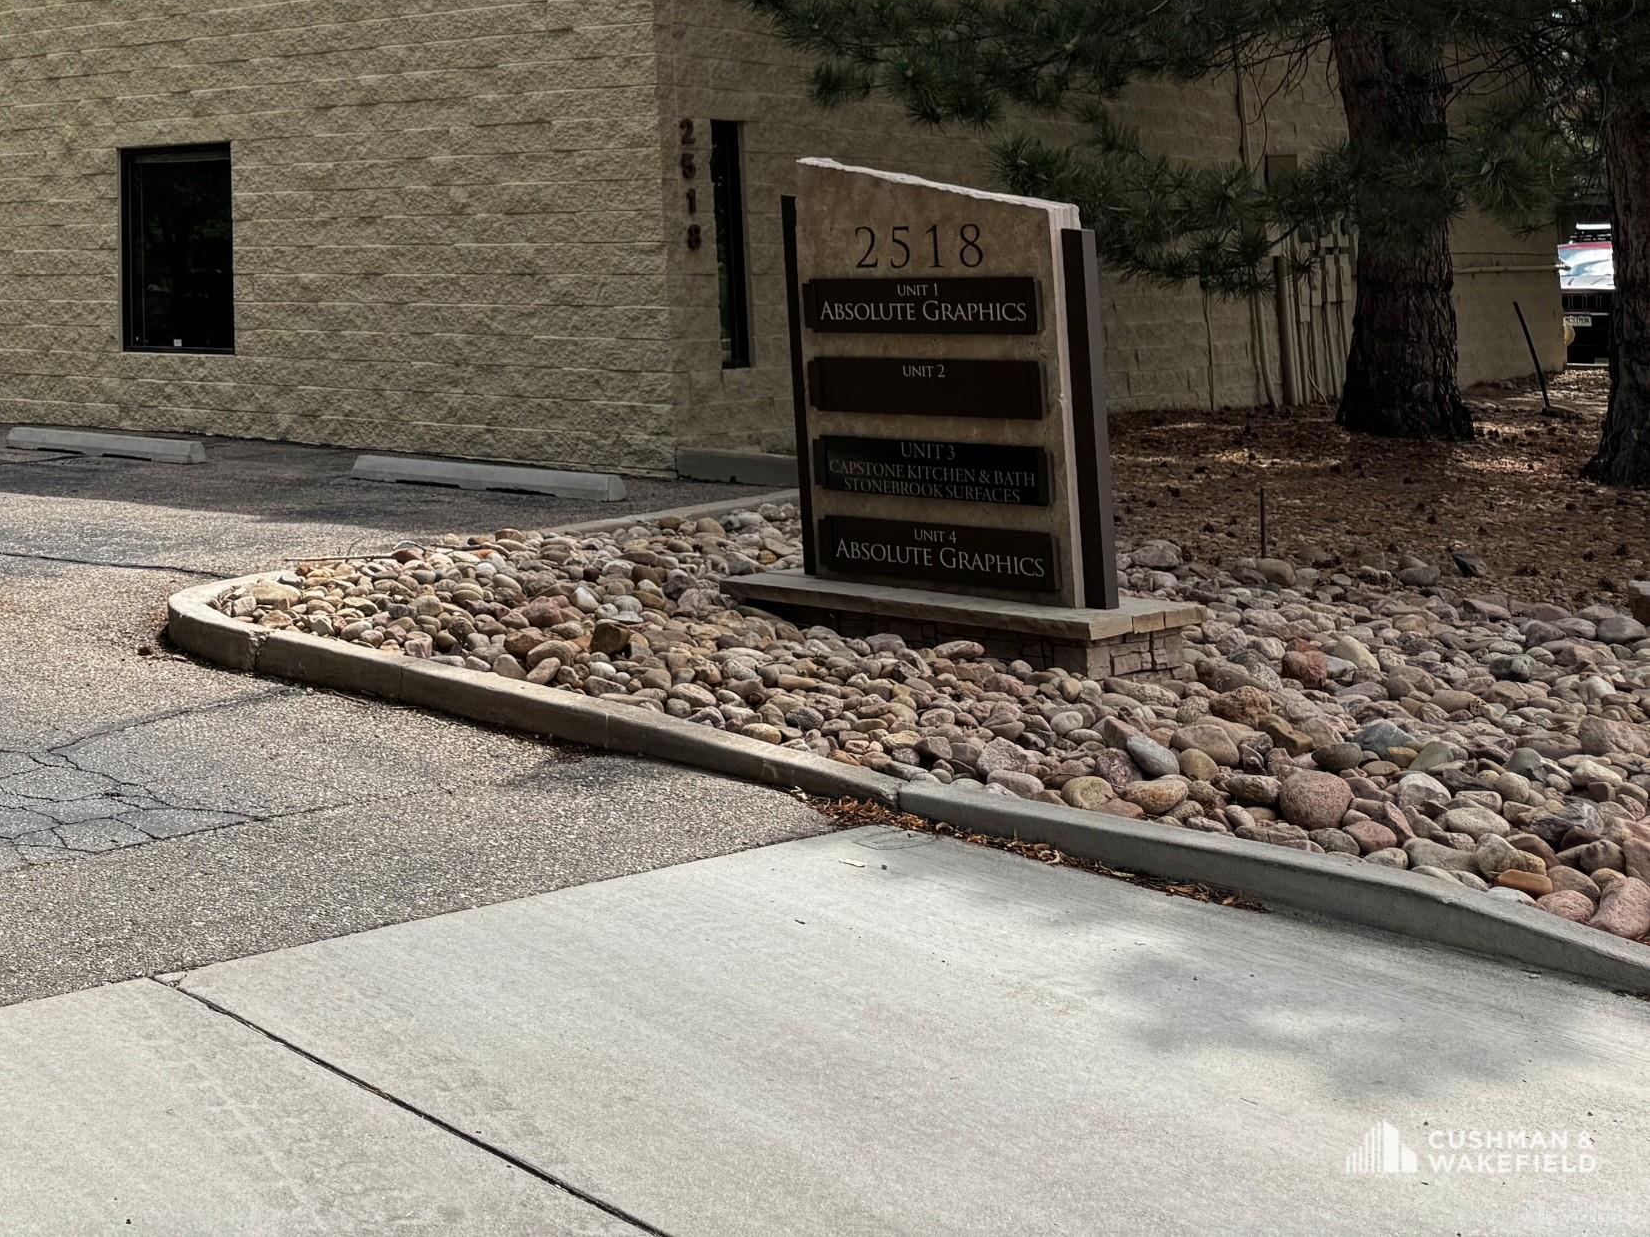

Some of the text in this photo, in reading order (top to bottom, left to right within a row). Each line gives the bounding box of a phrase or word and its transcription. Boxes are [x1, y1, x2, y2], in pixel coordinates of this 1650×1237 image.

[679, 118, 702, 251] 2518
[854, 223, 984, 269] 2518
[896, 282, 938, 297] UNIT 1
[902, 364, 946, 378] UNIT 2
[900, 441, 956, 460] UNIT 3
[829, 459, 1036, 488] CAPSTONE KITCHEN & BATH
[843, 477, 1021, 504] STONEBROOK SURFACES
[913, 528, 957, 544] UNIT 4
